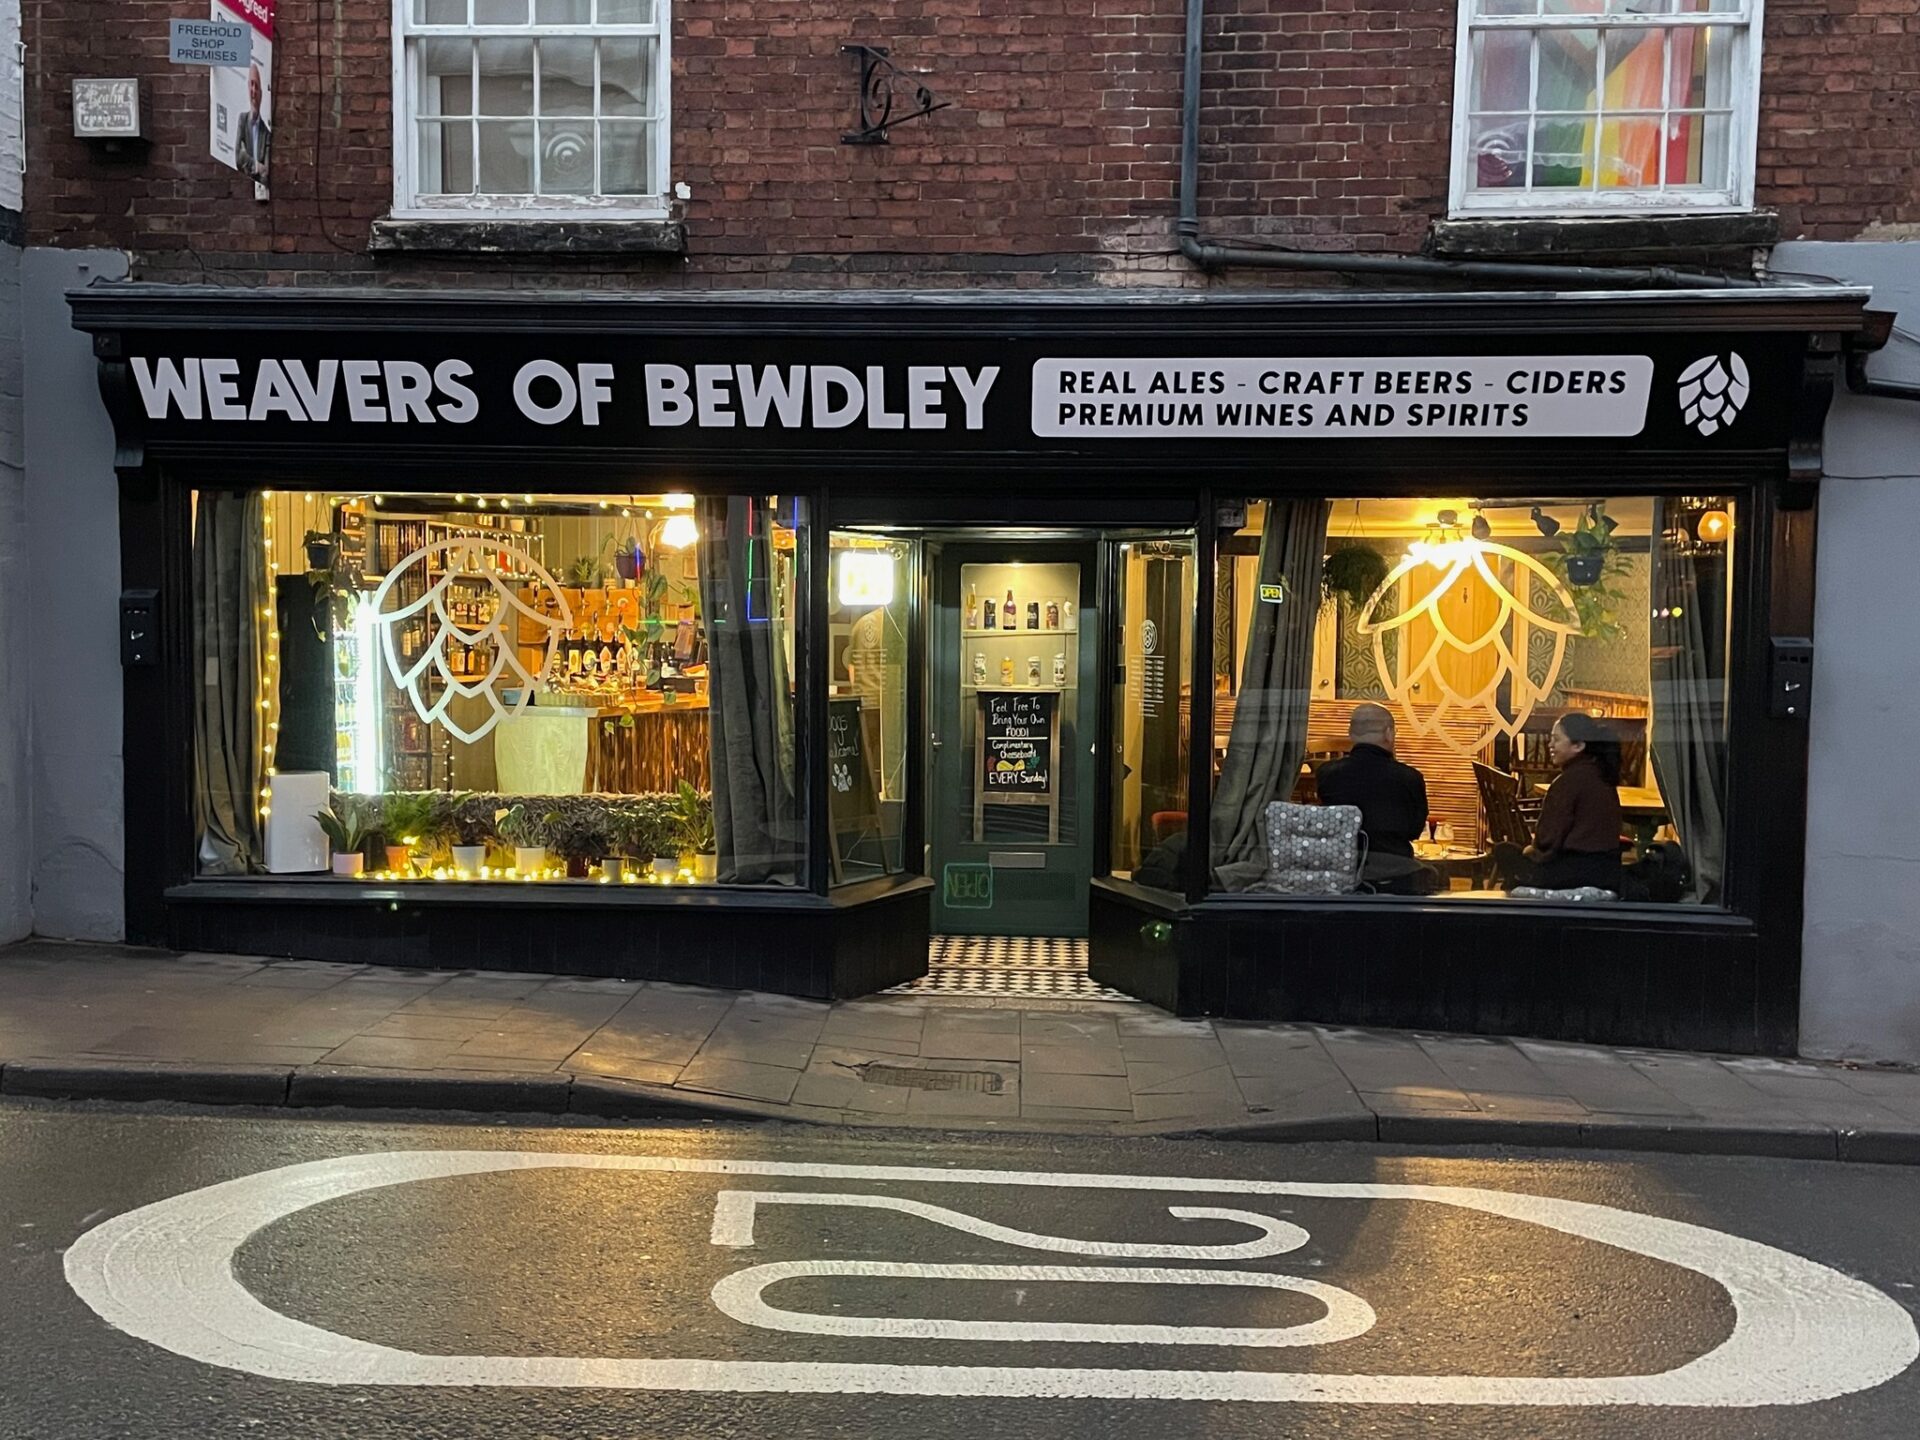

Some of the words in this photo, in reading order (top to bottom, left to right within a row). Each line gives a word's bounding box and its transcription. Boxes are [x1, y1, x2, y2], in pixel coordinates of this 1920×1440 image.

[238, 0, 268, 24] greed
[178, 25, 242, 38] FREEHOLD
[191, 38, 225, 49] SHOP
[176, 48, 238, 62] PREMISES
[1059, 370, 1136, 394] REAL
[1148, 370, 1225, 394] ALES
[1258, 370, 1365, 394] CRAFT
[1374, 370, 1473, 394] BEERS
[1506, 370, 1626, 394] CIDERS
[130, 357, 478, 424] WEAVERS
[513, 359, 614, 426] OF
[645, 364, 1001, 430] BEWDLEY
[1058, 403, 1204, 426] PREMIUM
[1216, 403, 1314, 427] WINES
[1324, 403, 1395, 427] AND
[1406, 403, 1529, 427] SPIRITS
[990, 697, 1007, 713] Feel
[1013, 696, 1028, 712] Free
[1030, 696, 1040, 710] To
[992, 713, 1012, 729] Bring
[1012, 713, 1028, 726] Your
[1030, 713, 1045, 725] Own
[989, 771, 1019, 784] EVERY
[1020, 769, 1048, 789] Sunday!
[710, 1189, 1376, 1348] 20
